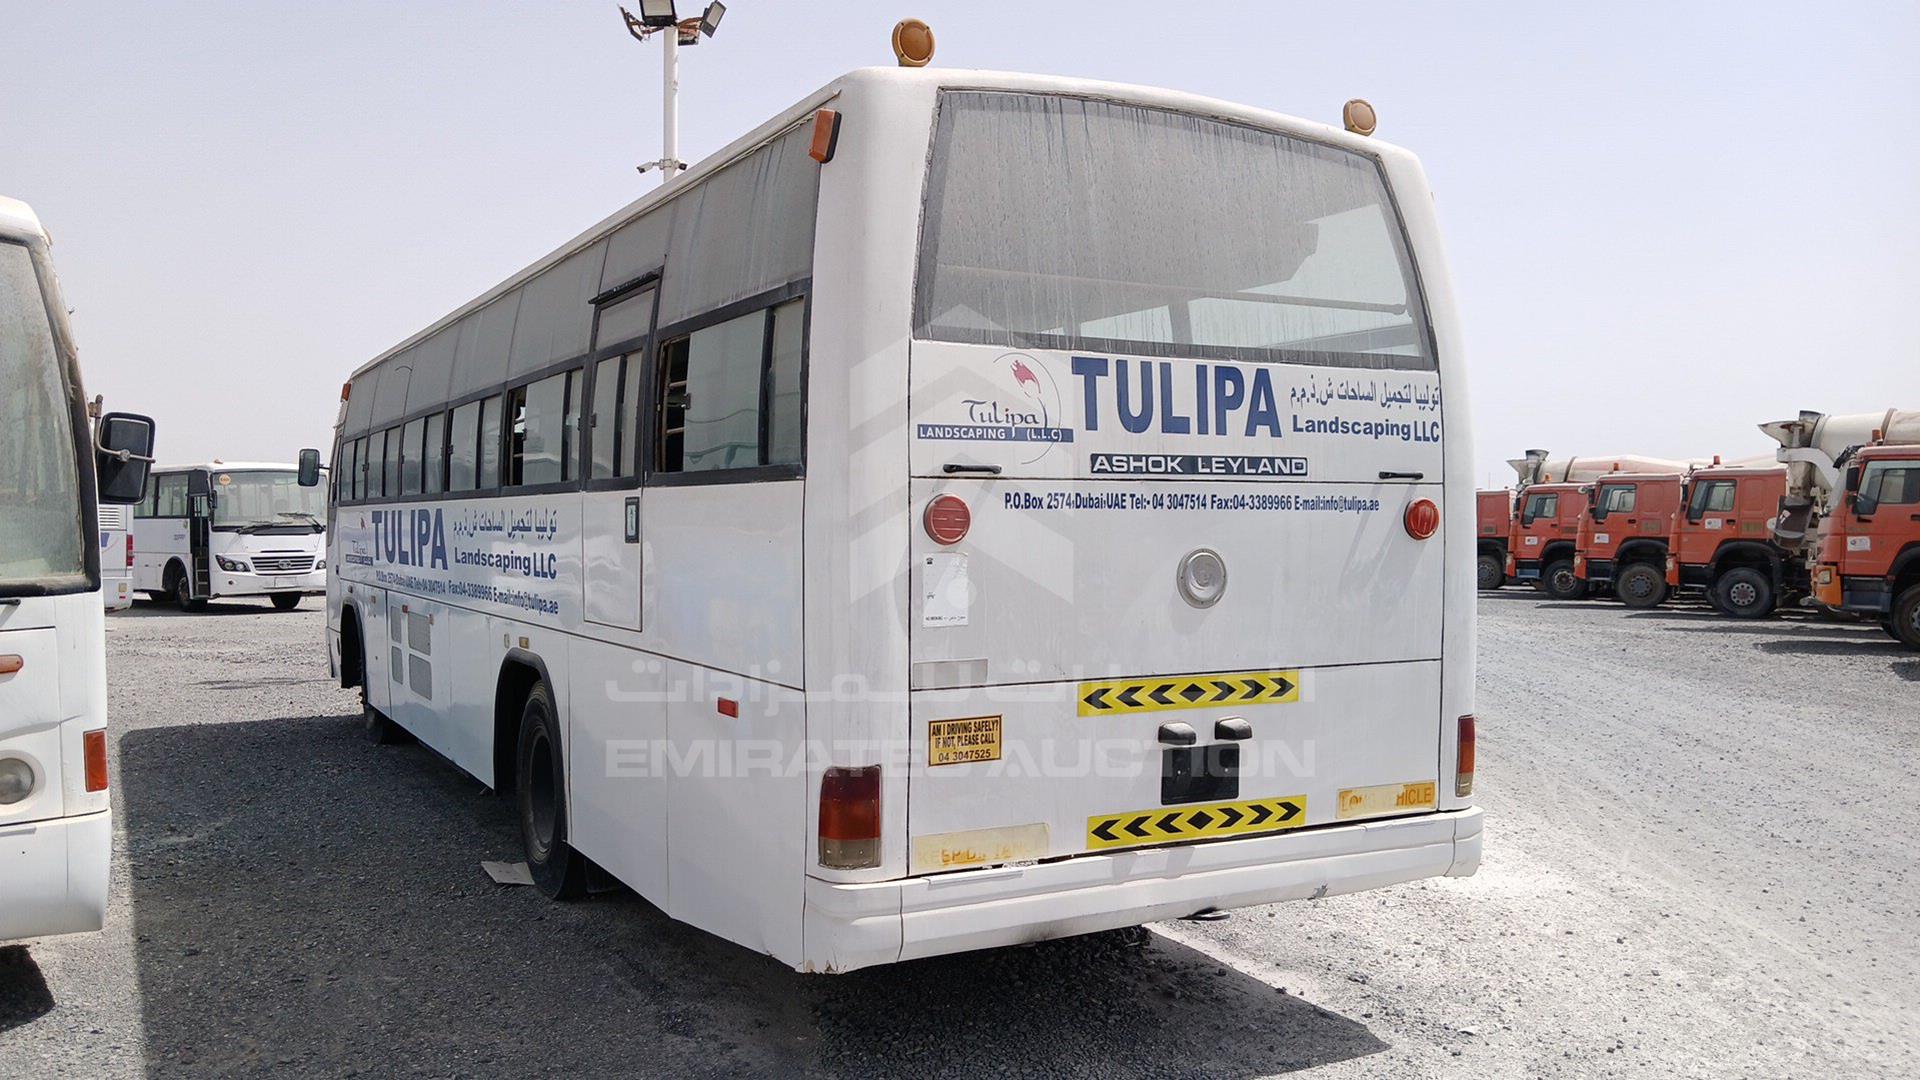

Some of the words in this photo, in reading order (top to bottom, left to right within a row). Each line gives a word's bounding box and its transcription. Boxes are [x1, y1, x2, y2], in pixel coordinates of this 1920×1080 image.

[1071, 356, 1283, 438] TULIPA
[961, 399, 1040, 438] Tulipa
[918, 425, 1006, 440] LANDSCAPING
[1026, 428, 1063, 442] (L.L.C)
[1292, 414, 1411, 442] Landscaping
[1413, 420, 1440, 443] LLC
[1092, 455, 1184, 473] ASHOK
[1197, 456, 1308, 474] LEYLAND
[1004, 492, 1044, 510] P.O.Box
[1152, 493, 1164, 510] 04
[1166, 493, 1208, 510] 3047514
[371, 508, 449, 570] TULIPA
[454, 547, 531, 577] Landscaping
[533, 551, 557, 580] LLC
[932, 724, 942, 737] AM
[947, 722, 972, 735] DRIVING
[973, 719, 999, 733] SAFELY?
[957, 734, 979, 747] PLEASE
[980, 732, 995, 745] CALL
[938, 751, 950, 762] 04
[952, 748, 991, 761] 3047525
